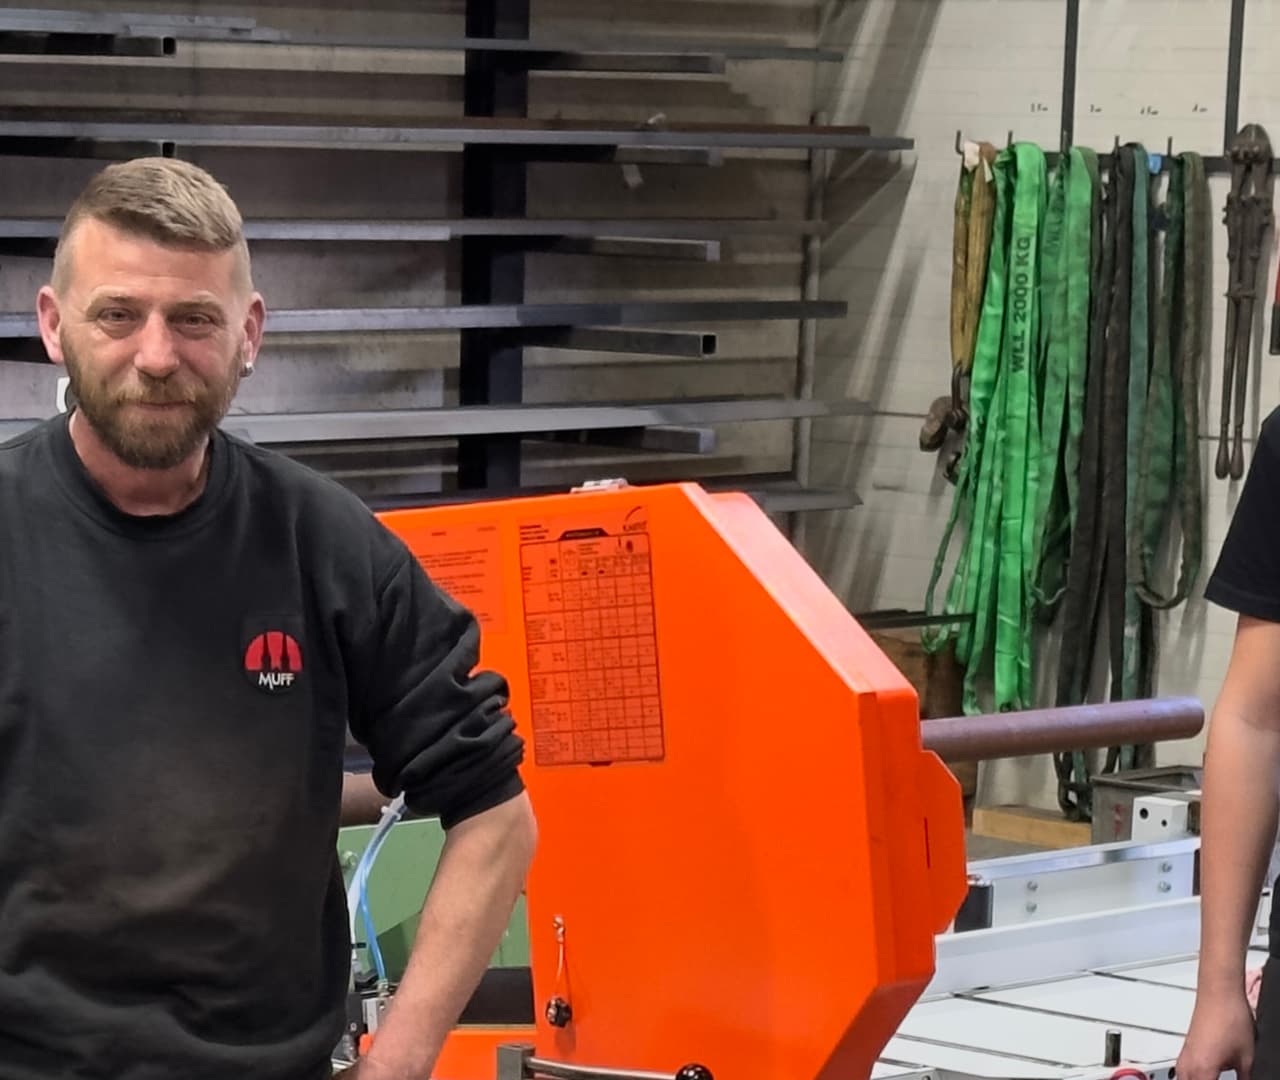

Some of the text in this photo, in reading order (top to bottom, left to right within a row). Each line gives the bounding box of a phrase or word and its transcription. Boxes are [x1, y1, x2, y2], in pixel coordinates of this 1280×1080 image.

[1010, 237, 1031, 373] WLL 2000 KG
[258, 672, 295, 690] MUFF
